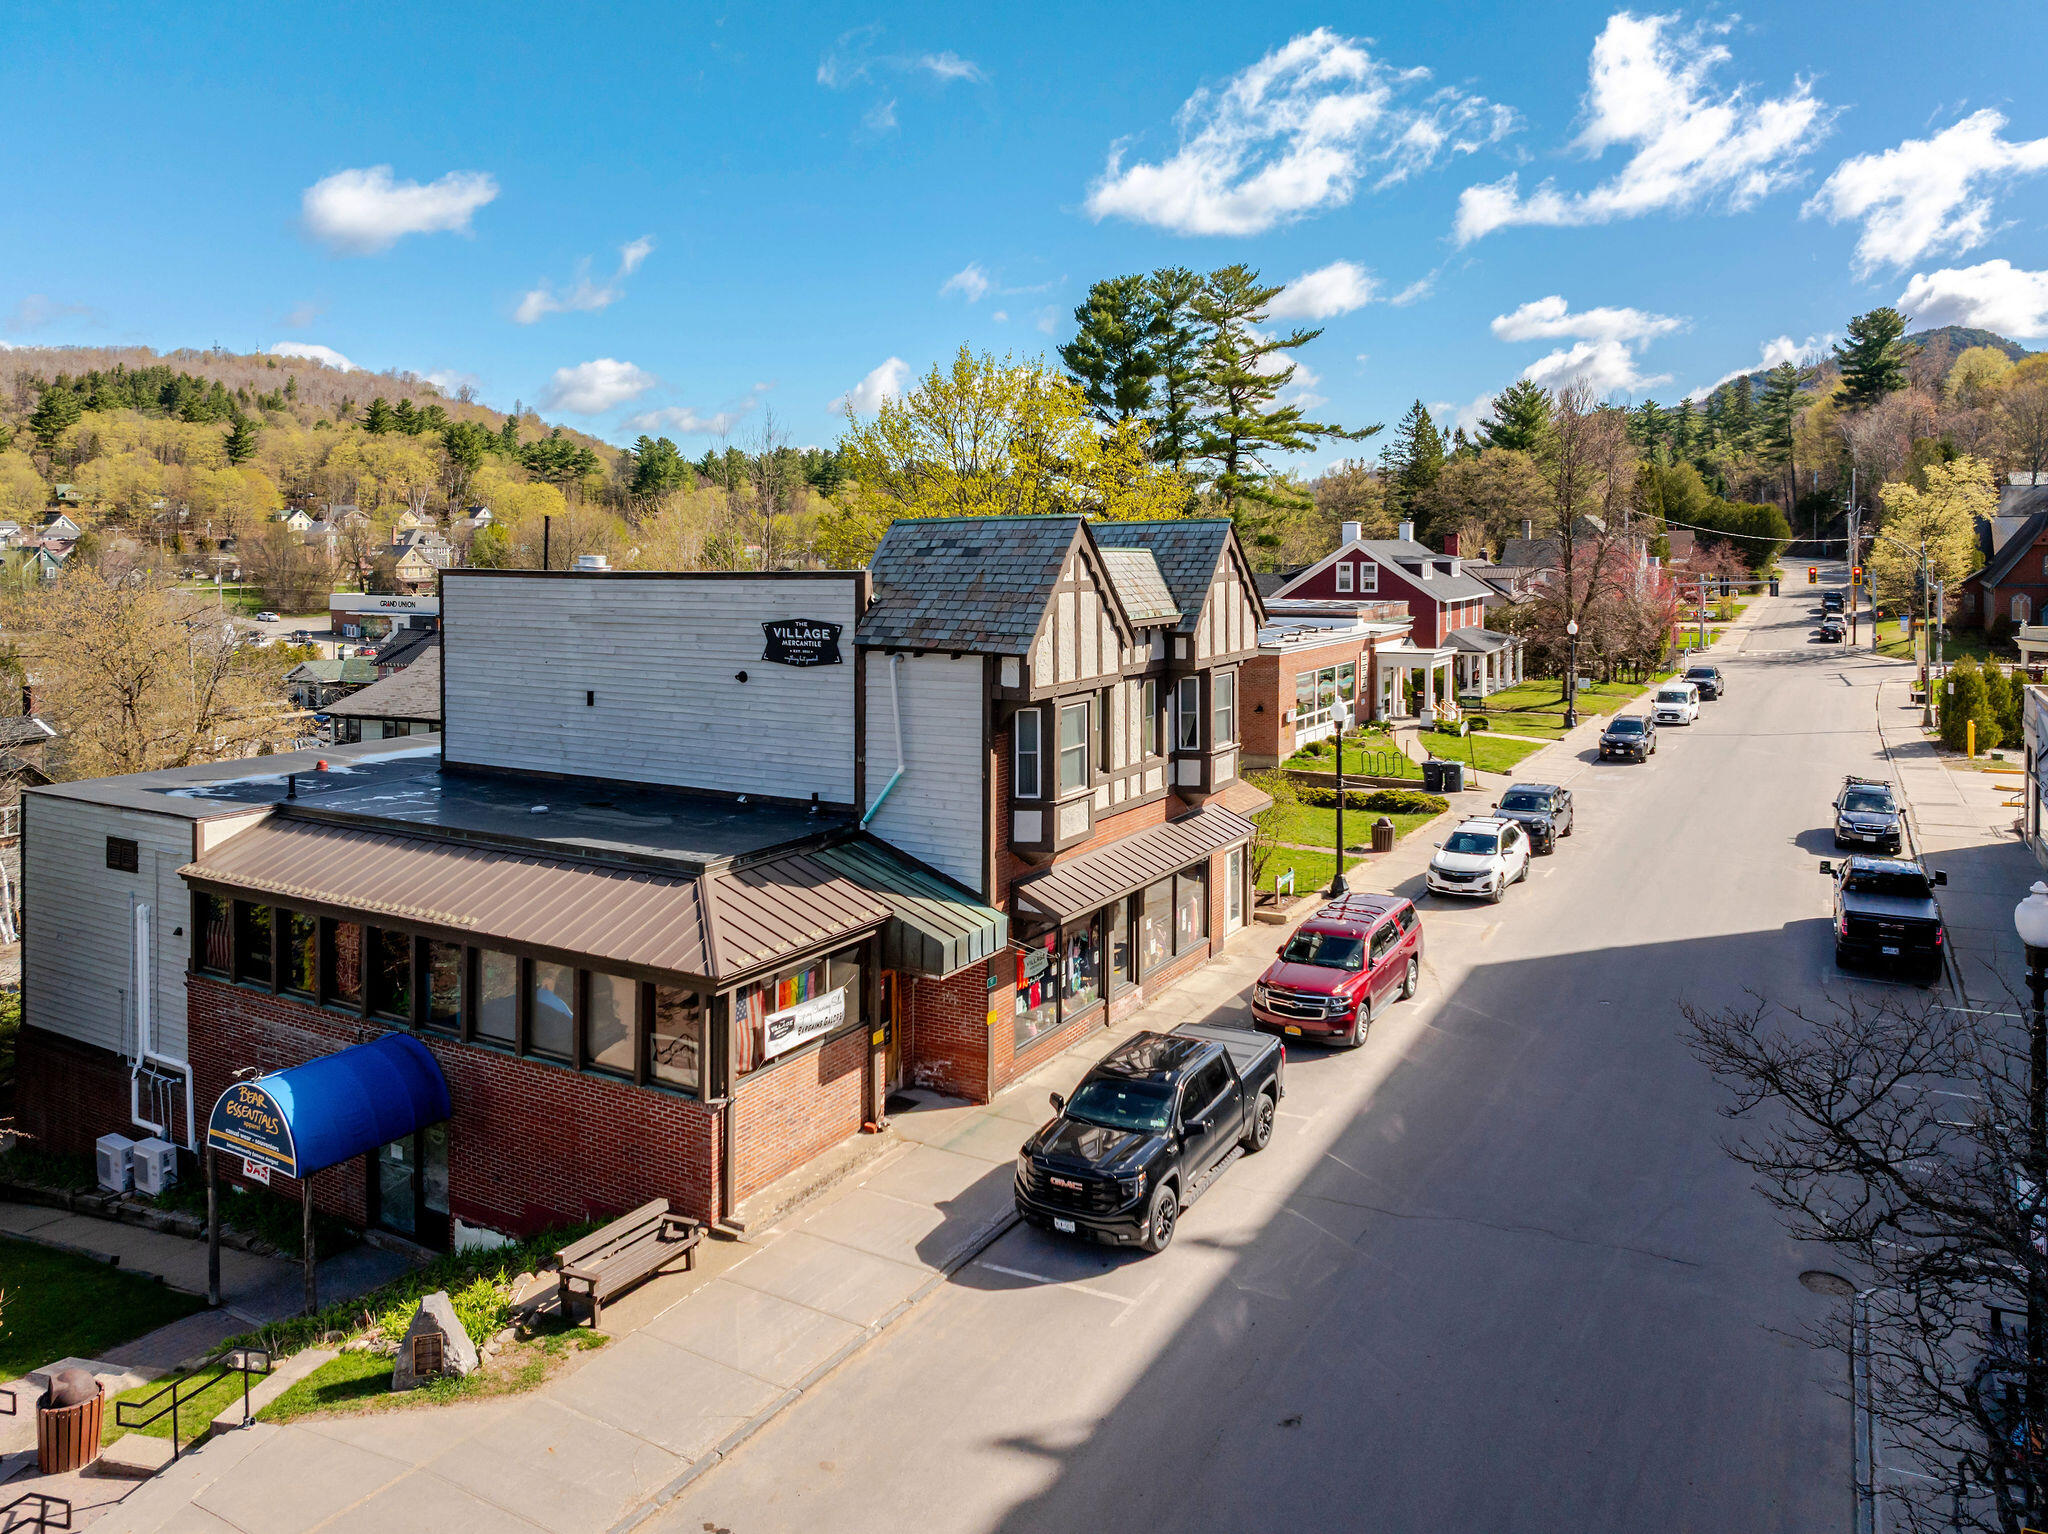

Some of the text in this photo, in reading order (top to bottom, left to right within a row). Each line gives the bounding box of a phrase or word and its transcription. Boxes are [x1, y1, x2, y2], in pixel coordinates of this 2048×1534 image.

[773, 627, 831, 640] VILLAGE
[781, 640, 822, 648] MERCANTILE
[238, 1086, 268, 1109] BEAR
[226, 1100, 279, 1135] ESSENTIALS
[1050, 1176, 1083, 1191] GMC
